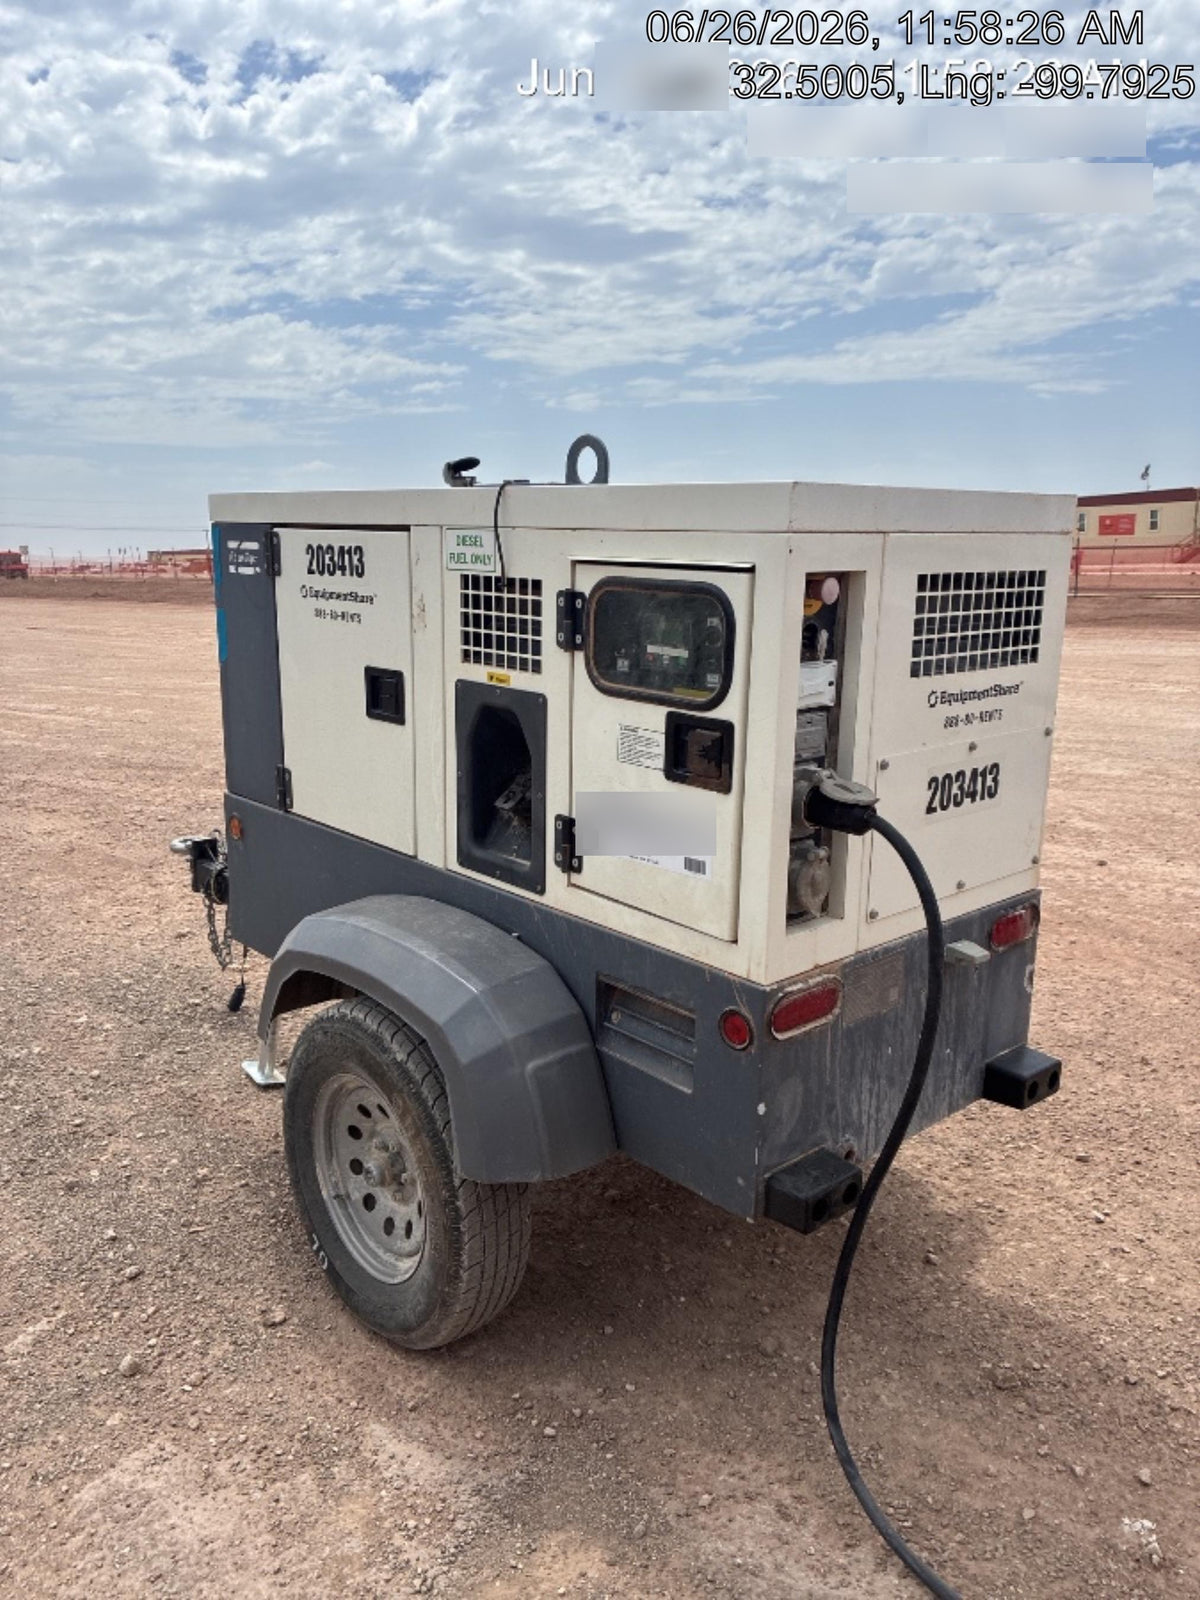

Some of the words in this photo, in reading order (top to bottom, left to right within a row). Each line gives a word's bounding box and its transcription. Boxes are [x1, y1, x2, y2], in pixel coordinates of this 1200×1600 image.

[456, 534, 484, 548] DIESEL
[306, 543, 366, 579] 203413
[449, 552, 469, 565] FUEL
[470, 553, 493, 566] ONLY
[925, 761, 1001, 815] 203413
